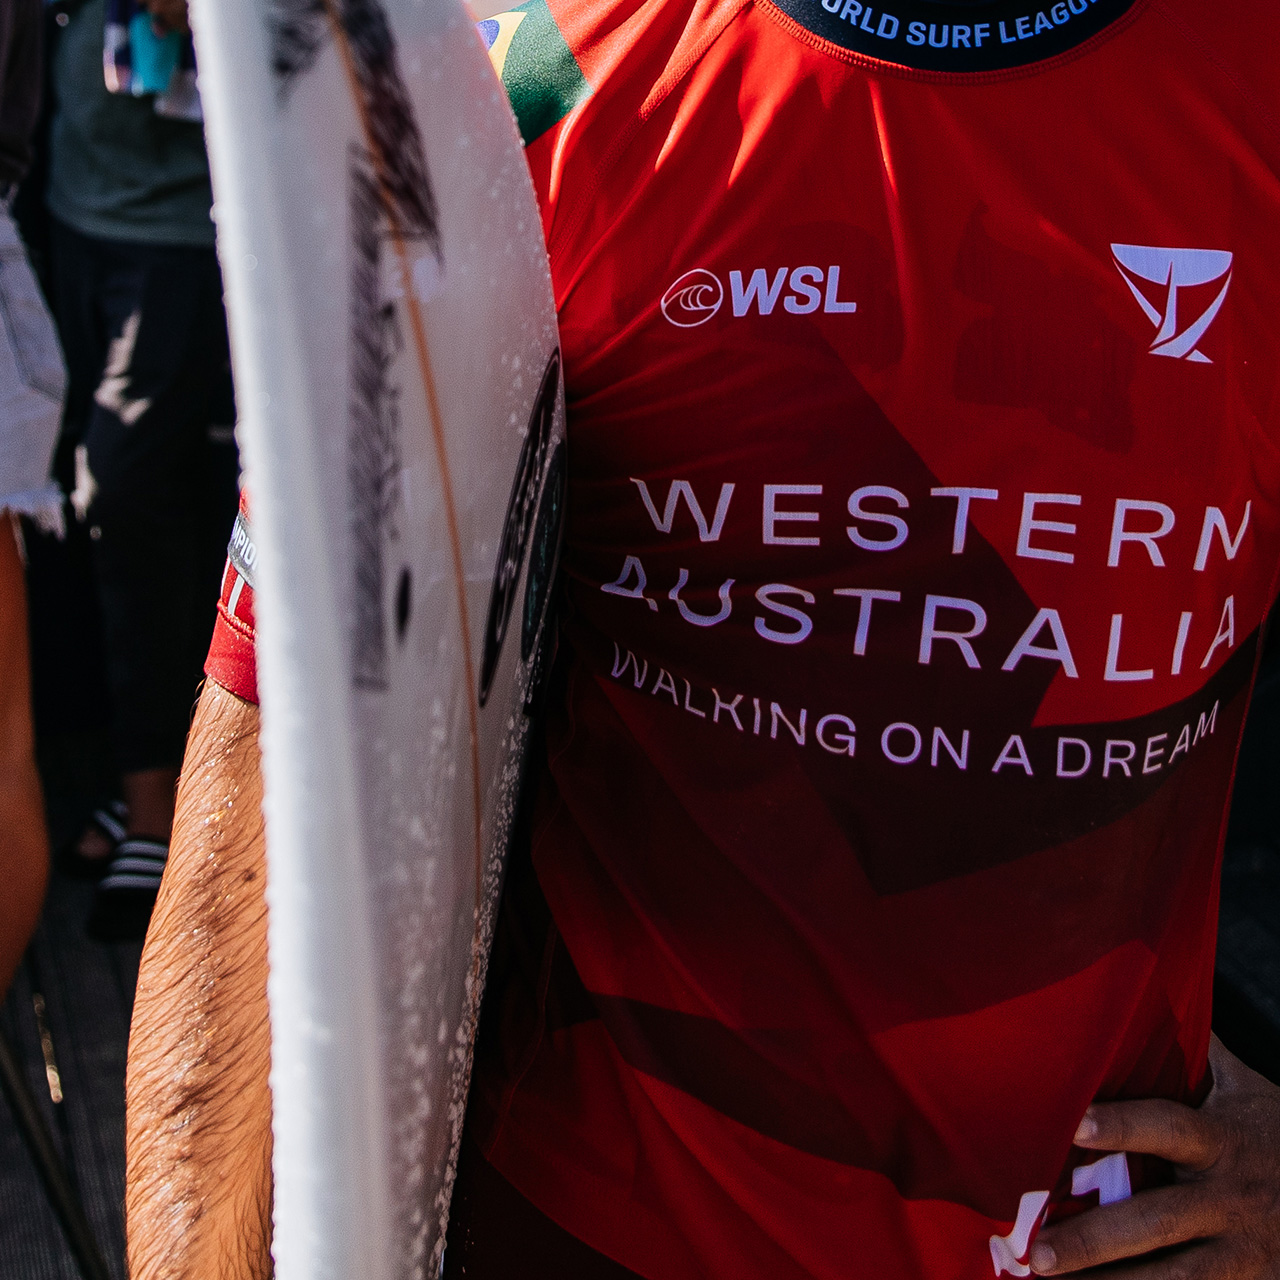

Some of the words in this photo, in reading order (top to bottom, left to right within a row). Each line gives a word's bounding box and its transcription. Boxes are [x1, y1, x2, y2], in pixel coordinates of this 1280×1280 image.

[906, 21, 991, 49] SURF
[729, 265, 857, 318] WSL
[629, 477, 1252, 572] WESTERN
[600, 555, 1236, 682] AUSTRALIA
[611, 640, 857, 756] WALKING
[879, 721, 970, 771] ON
[991, 734, 1034, 777] A
[1056, 699, 1220, 780] DREAM
